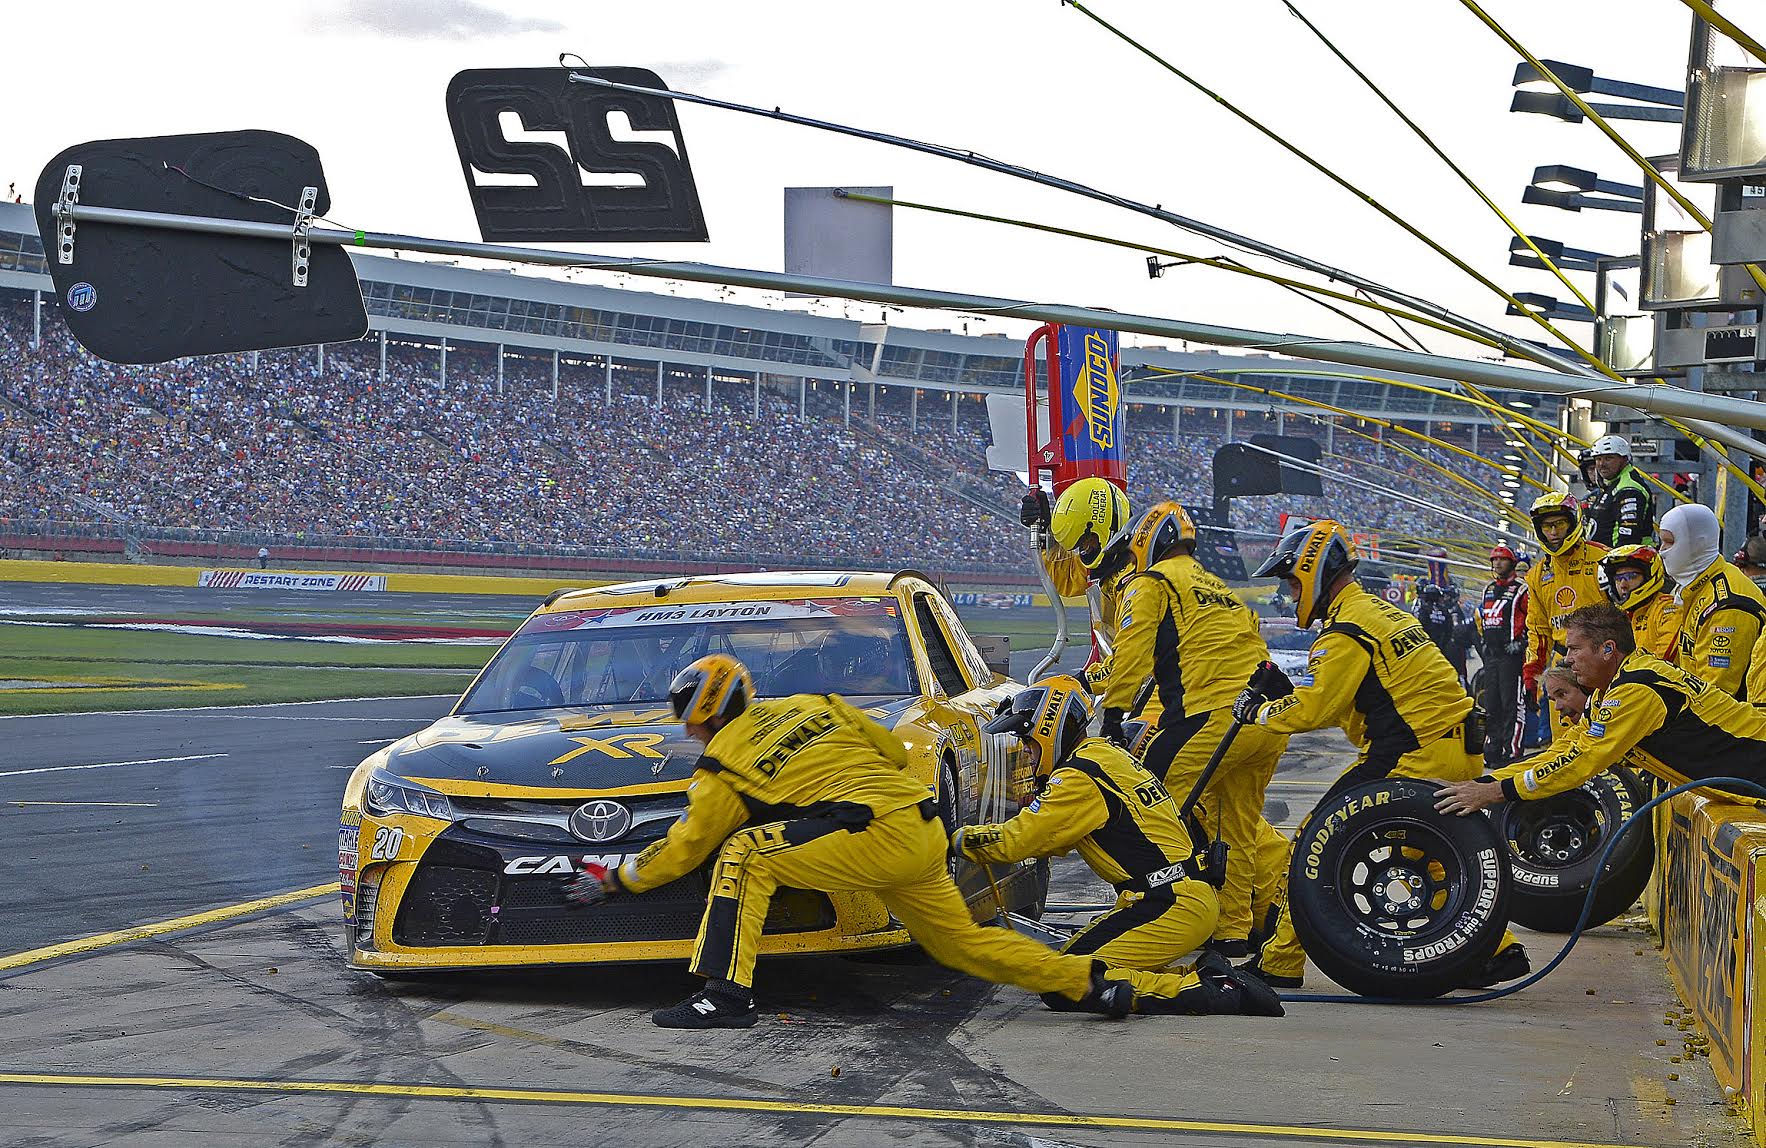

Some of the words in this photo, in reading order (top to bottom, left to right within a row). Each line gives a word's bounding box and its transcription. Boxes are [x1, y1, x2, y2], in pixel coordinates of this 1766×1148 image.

[1088, 339, 1111, 445] SUNOCO
[1091, 490, 1101, 522] DOLLAR
[1098, 488, 1106, 524] GENERAL
[1301, 530, 1328, 574] DEWALT
[244, 575, 299, 586] RESTART
[301, 577, 336, 587] ZONE
[635, 609, 683, 622] HM3
[689, 605, 772, 619] LAYTON
[1040, 689, 1066, 738] DEWALT
[546, 733, 664, 766] XR
[756, 712, 836, 779] DEWALT
[1535, 746, 1583, 780] DEWALT
[371, 826, 405, 860] 20
[1305, 791, 1391, 880] GOODYEAR
[503, 853, 638, 875] CAM
[1473, 848, 1498, 921] SUPPORT
[1462, 917, 1479, 935] OUR
[1403, 932, 1467, 961] TROOPS
